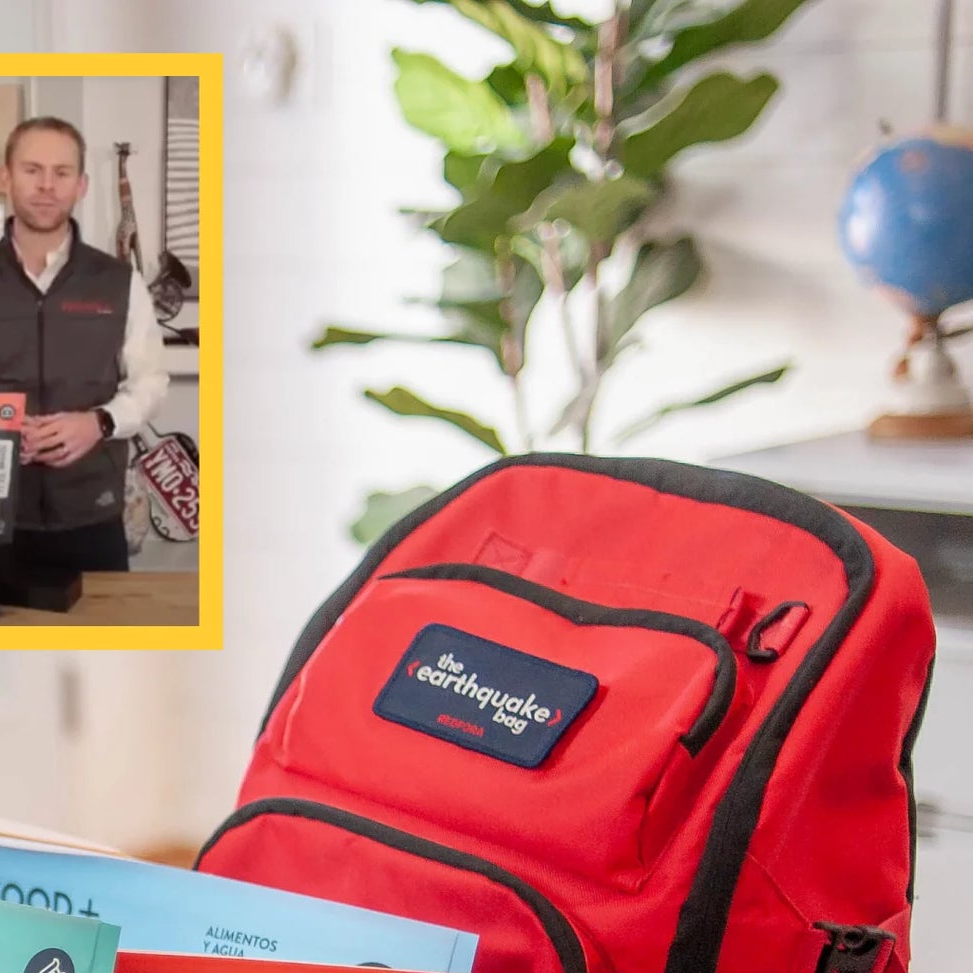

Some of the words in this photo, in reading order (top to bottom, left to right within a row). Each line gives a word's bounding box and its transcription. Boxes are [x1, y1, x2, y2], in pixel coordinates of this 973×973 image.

[437, 652, 464, 675] the
[416, 664, 551, 724] earthquake
[492, 706, 528, 735] bag
[203, 940, 210, 954] Y
[205, 925, 279, 953] ALIMENTOS
